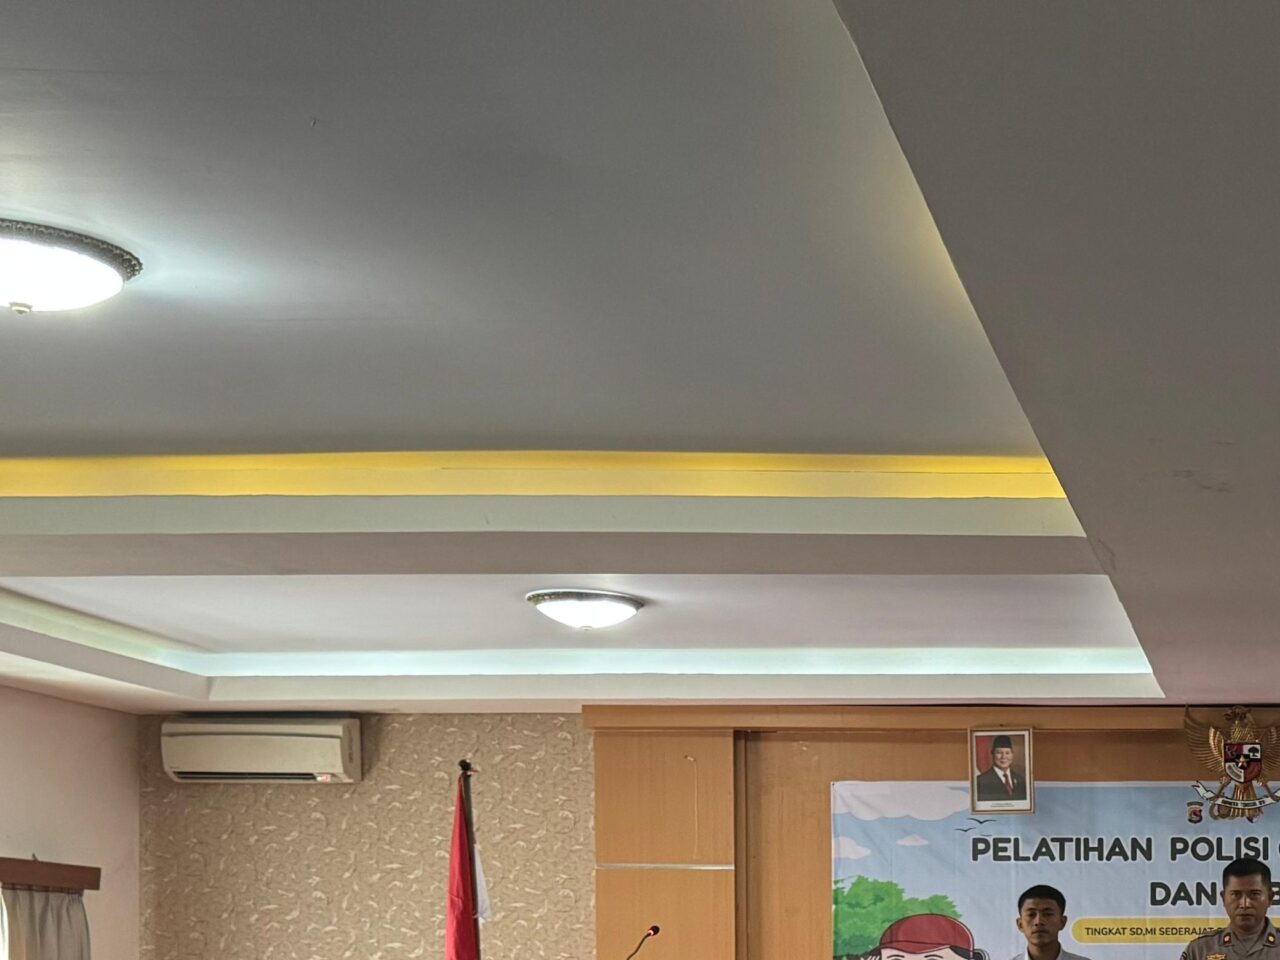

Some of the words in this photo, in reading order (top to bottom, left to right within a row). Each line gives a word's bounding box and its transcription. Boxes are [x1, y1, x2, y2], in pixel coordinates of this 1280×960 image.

[971, 837, 1153, 861] PELATIHAN
[1170, 836, 1269, 861] POLISI
[1150, 881, 1217, 906] DAN
[1085, 927, 1126, 936] TINGKAT
